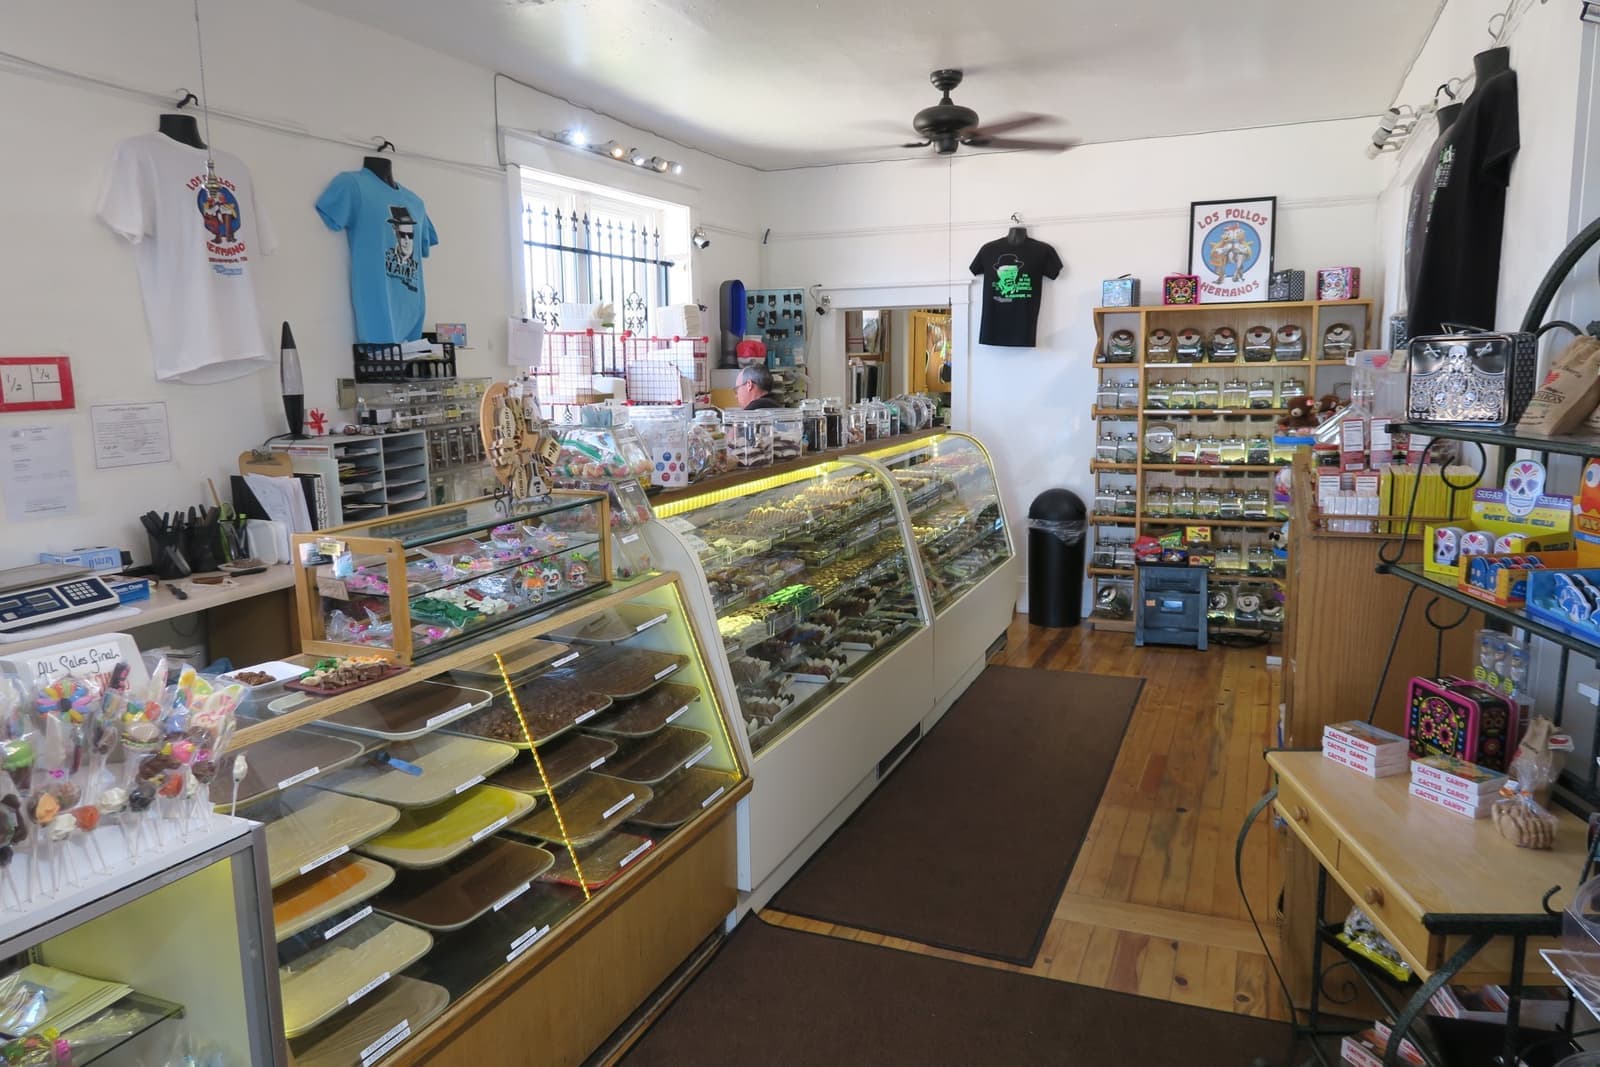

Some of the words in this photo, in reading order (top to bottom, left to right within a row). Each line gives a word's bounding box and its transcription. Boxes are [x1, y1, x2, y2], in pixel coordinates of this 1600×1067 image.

[1197, 211, 1220, 229] LOS
[1225, 208, 1268, 226] POLLOS
[1200, 280, 1260, 297] HERMANOS
[7, 374, 22, 392] 1/2
[1476, 489, 1504, 500] SUGAR
[38, 662, 58, 676] ALL
[59, 655, 88, 672] Sales
[1327, 741, 1346, 753] CACTUS
[1349, 750, 1368, 762] CANDY
[1328, 731, 1348, 742] CACTUS
[1350, 740, 1370, 751] CANDY
[1327, 752, 1347, 763] CACTUS
[1350, 761, 1368, 772] CANDY
[1417, 766, 1442, 780] CACTUS
[1446, 776, 1469, 789] CANDY
[1415, 788, 1439, 802] CACTUS
[1443, 798, 1466, 812] CANDY
[1418, 778, 1442, 791] CACTUS
[1446, 788, 1470, 801] CANDY
